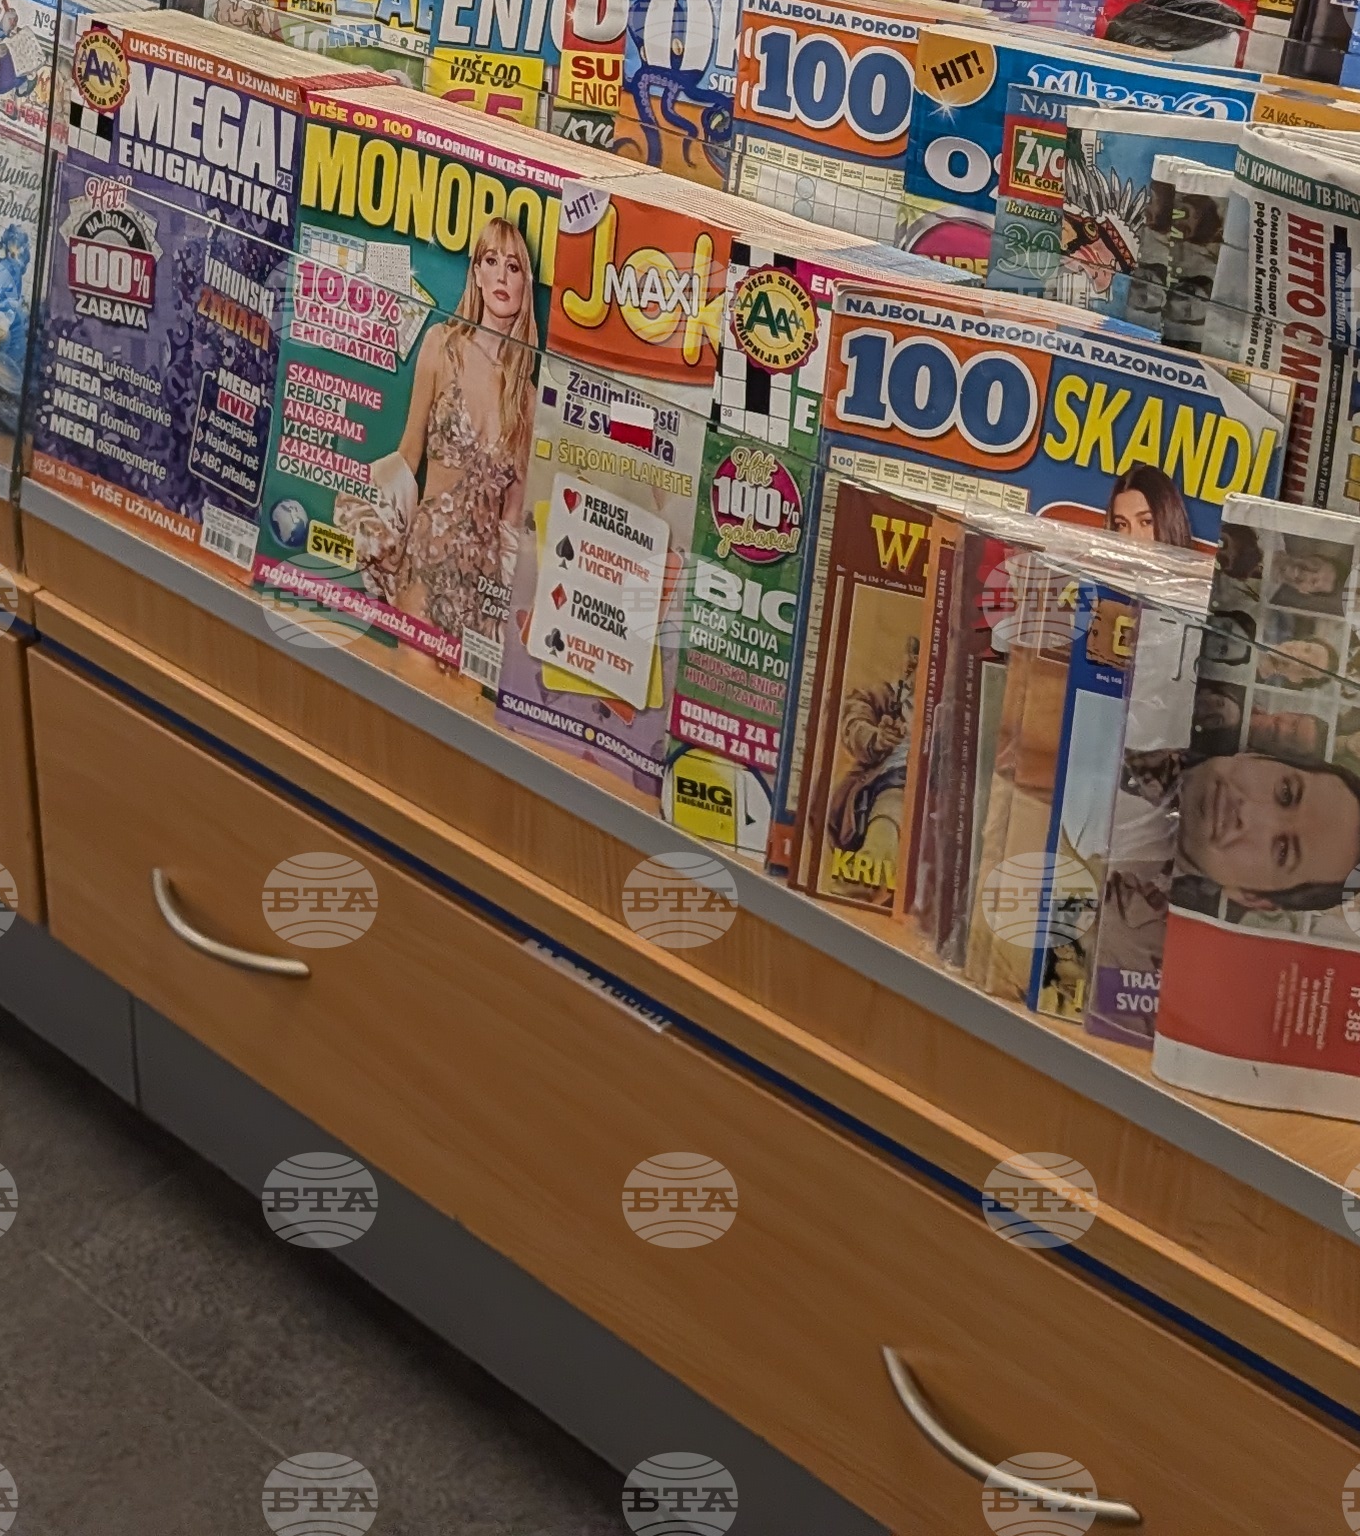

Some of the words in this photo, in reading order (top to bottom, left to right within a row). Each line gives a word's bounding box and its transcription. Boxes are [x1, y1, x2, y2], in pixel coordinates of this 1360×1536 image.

[128, 38, 213, 75] UKRŠTENICE
[216, 63, 233, 81] ZA
[236, 68, 298, 106] UŽIVANJE!
[752, 26, 915, 143] 100
[931, 50, 984, 91] HIT!
[120, 60, 298, 189] MEGA!
[308, 99, 348, 123] VIŠE
[352, 109, 377, 129] OD
[383, 116, 413, 139] 100
[416, 130, 483, 161] KOLORNIH
[119, 137, 289, 227] ENIGMATIKA
[1251, 161, 1312, 200] КРИМИНАЛ
[75, 294, 149, 331] ZABAVA
[604, 263, 700, 318] MAXI
[846, 298, 956, 333] NAJBOLJA
[960, 318, 1086, 358] PORODIČNA
[1089, 344, 1208, 391] RAZONODA
[285, 384, 343, 413] REBUSI
[286, 364, 383, 411] SKANDINAVKE
[837, 329, 1036, 454] 100
[285, 402, 364, 441] ANAGRAMI
[1043, 374, 1278, 506] SKANDI
[278, 456, 379, 505] OSMOSMERKE
[557, 440, 617, 473] ŠIROM
[619, 461, 693, 498] PLANETE
[311, 534, 355, 561] SVET
[572, 591, 626, 624] DOMINO
[676, 777, 733, 808] BIG
